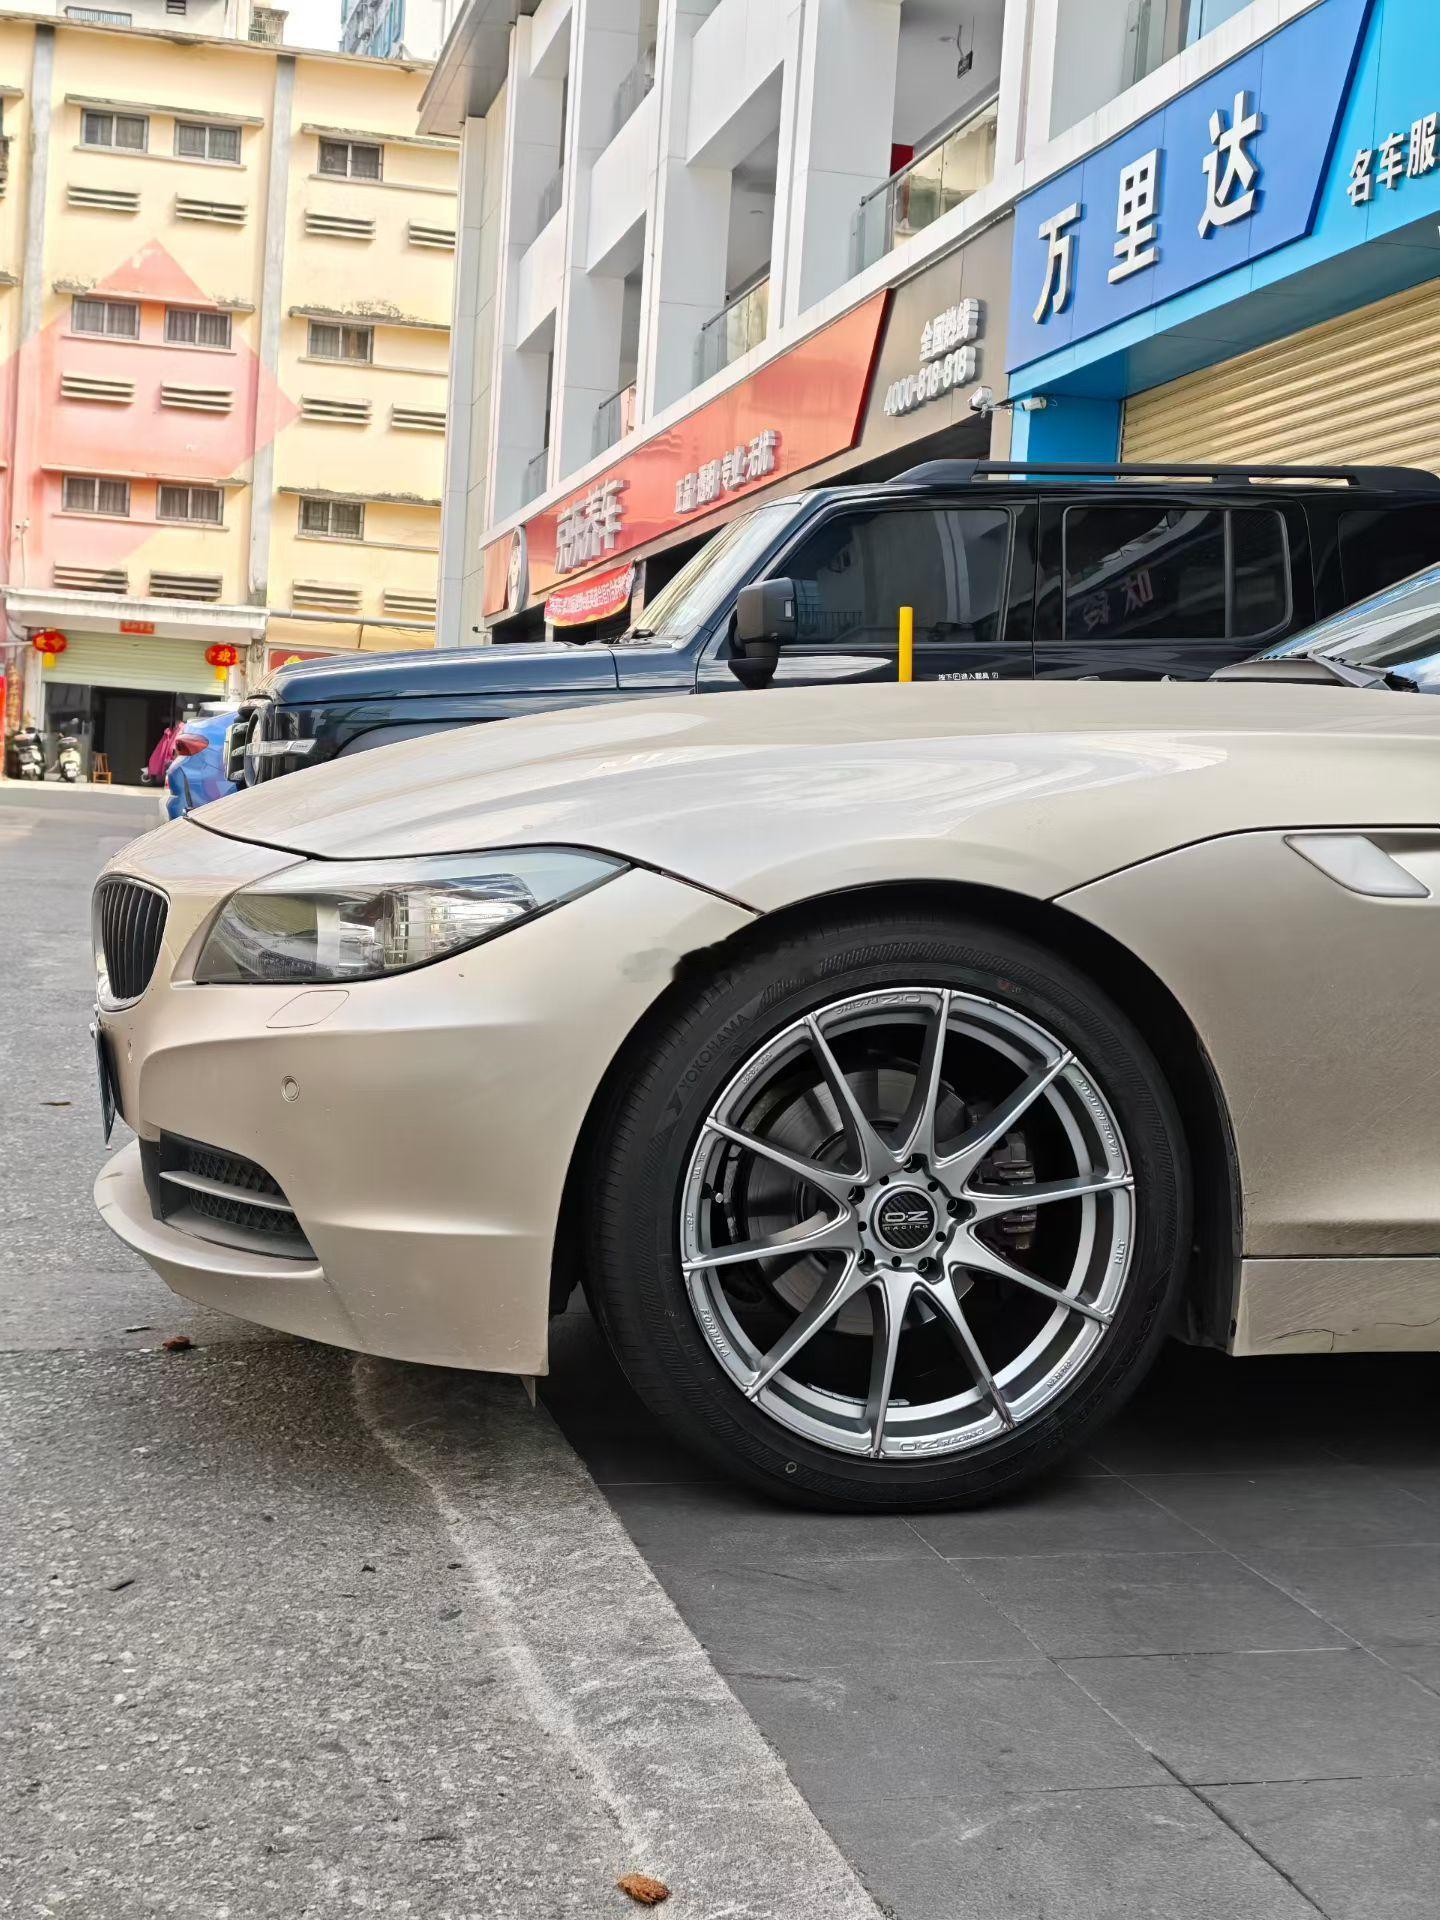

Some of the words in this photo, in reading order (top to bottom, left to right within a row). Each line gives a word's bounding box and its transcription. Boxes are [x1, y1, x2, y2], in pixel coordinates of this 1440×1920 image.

[1347, 111, 1439, 206] 名车服
[1033, 90, 1264, 325] 万里达
[919, 297, 979, 363] 全国热线
[554, 478, 626, 574] 京东养车
[679, 1013, 751, 1089] YOKOHAMA
[1100, 1122, 1120, 1158] MADE
[884, 1224, 929, 1232] RACING
[699, 1307, 731, 1358] FORMULA
